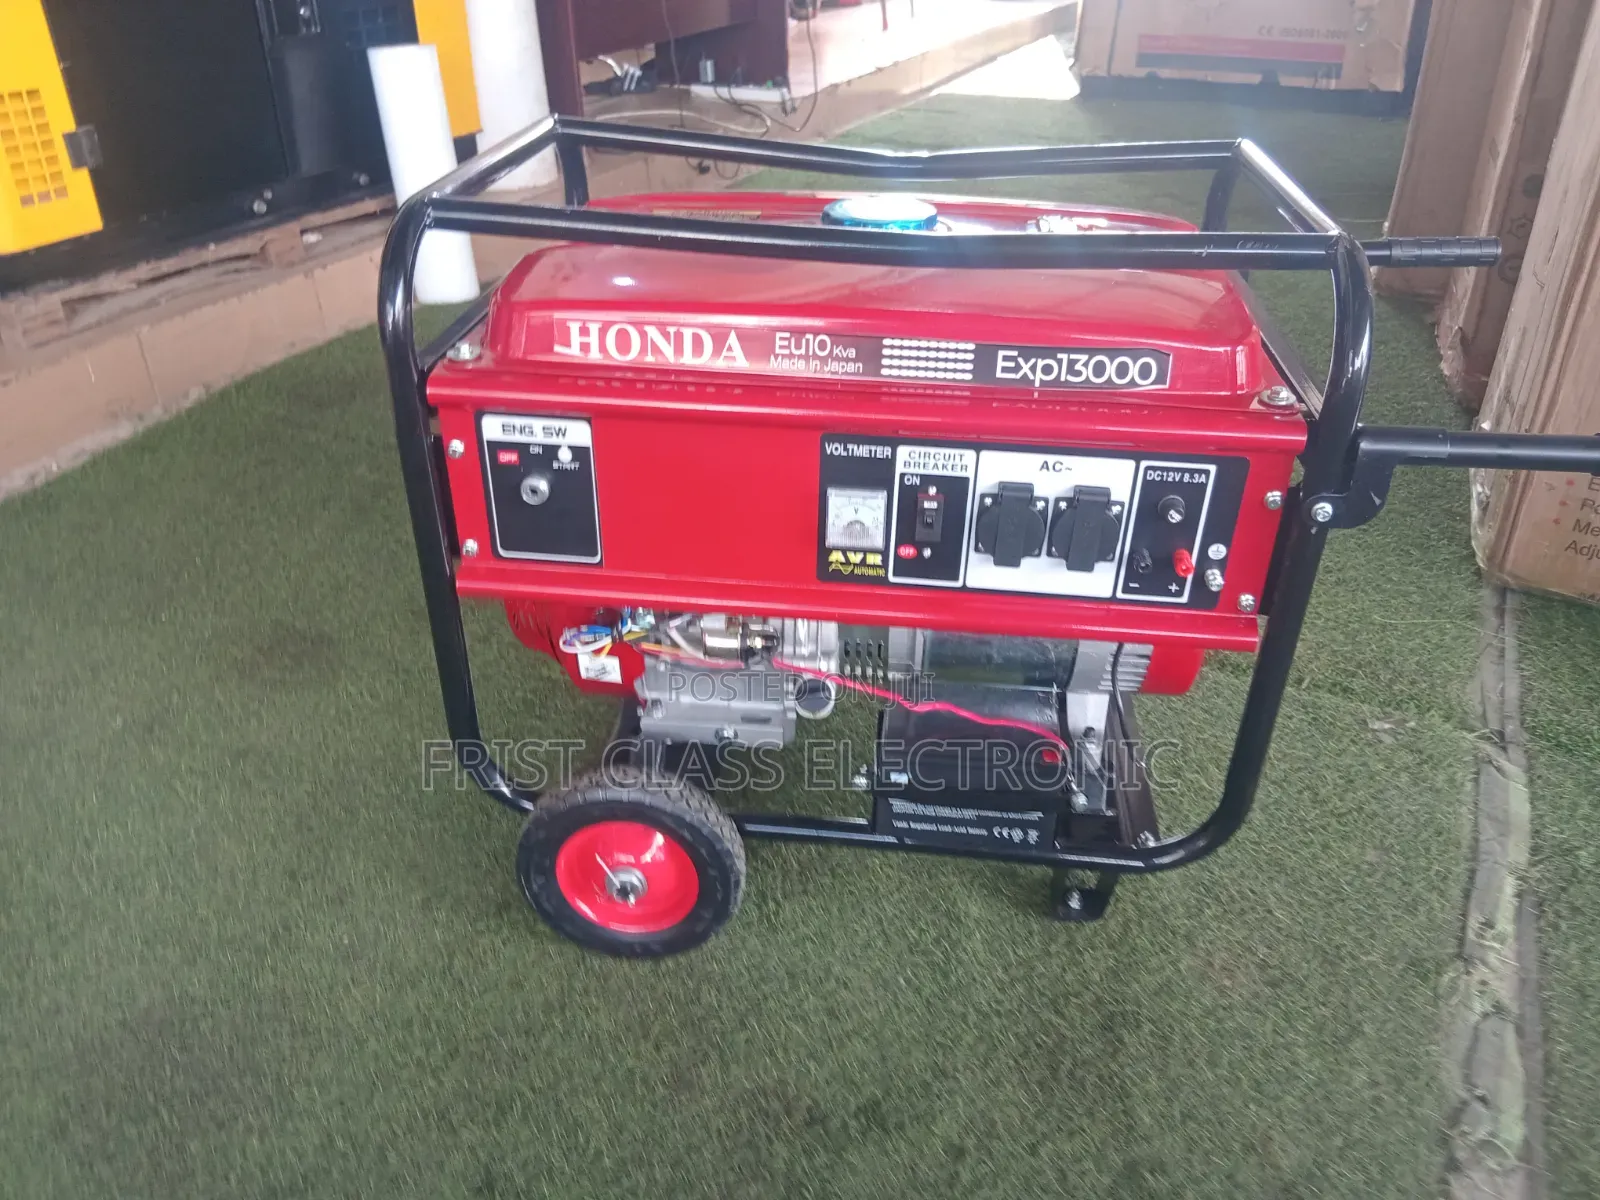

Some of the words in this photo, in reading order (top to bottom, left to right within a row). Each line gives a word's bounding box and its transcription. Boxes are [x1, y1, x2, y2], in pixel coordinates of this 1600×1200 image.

[566, 320, 750, 368] HONDA
[774, 331, 831, 357] Eu10
[832, 344, 857, 359] Kva
[769, 354, 808, 370] Made
[823, 358, 864, 374] Japan
[995, 350, 1157, 387] Exp13000
[501, 423, 538, 439] ENG.
[542, 425, 567, 439] SW
[825, 442, 892, 459] VOLTMETER
[908, 450, 966, 463] CIRCUIT
[903, 460, 969, 473] BREAKER
[904, 474, 921, 486] ON
[1146, 470, 1181, 482] DC12V
[1183, 472, 1206, 484] 8.3A
[828, 550, 882, 566] AVR
[899, 548, 915, 557] OFF
